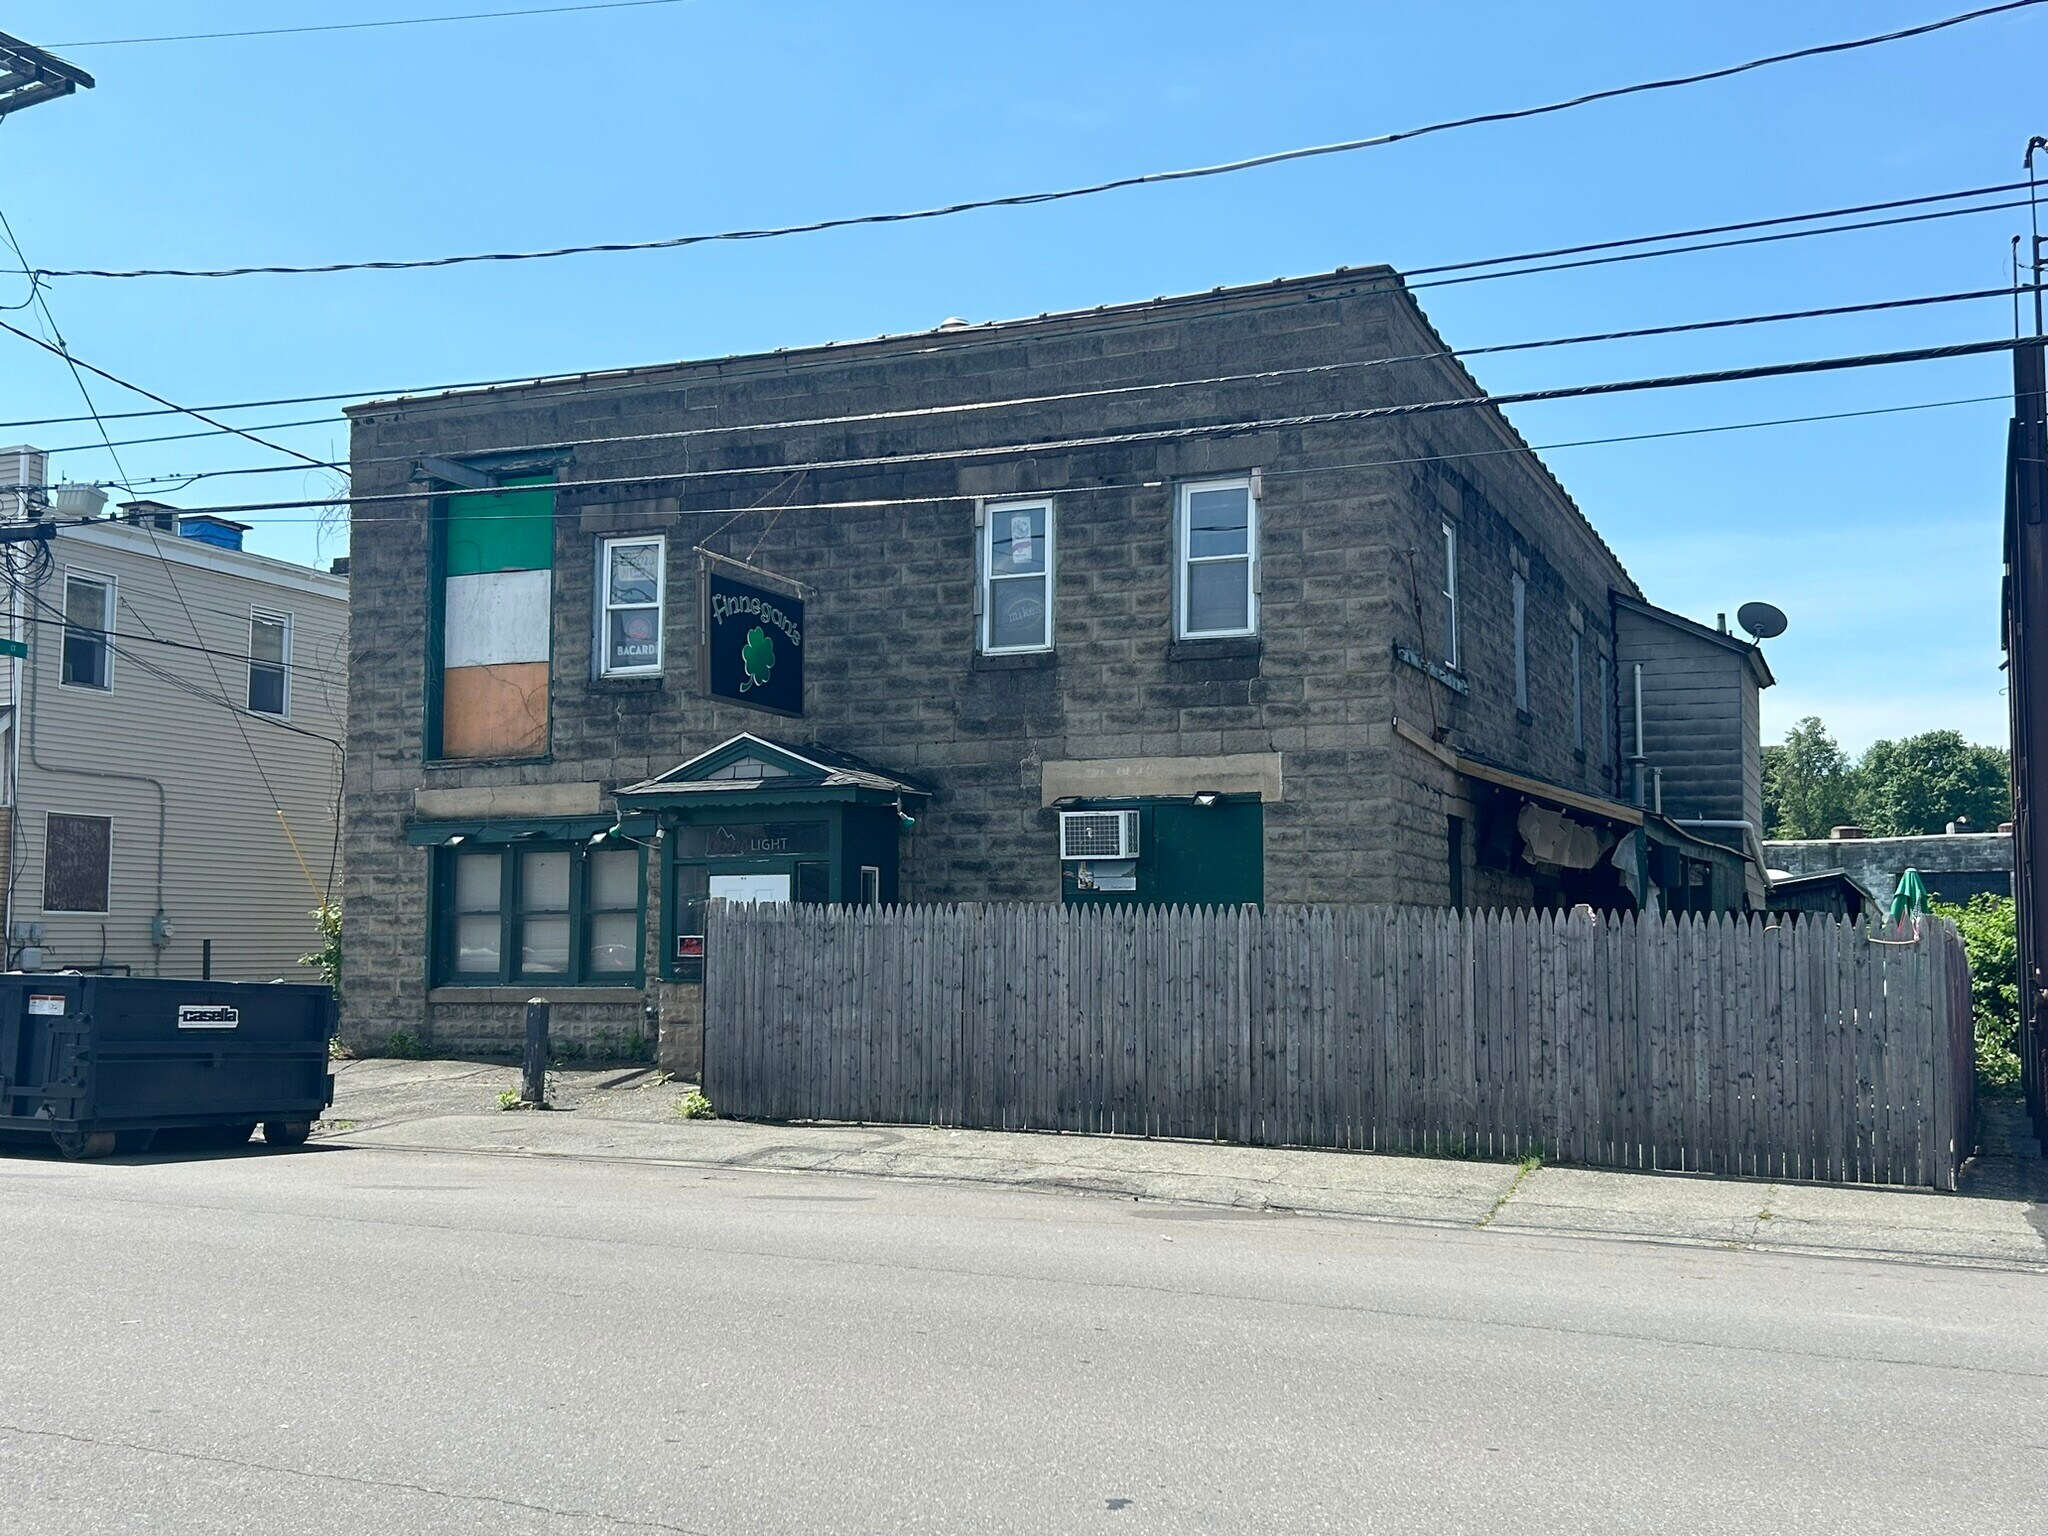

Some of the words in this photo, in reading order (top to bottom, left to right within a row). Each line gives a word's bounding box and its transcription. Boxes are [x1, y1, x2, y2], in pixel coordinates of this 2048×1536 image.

[712, 593, 802, 646] Finnegan's
[750, 838, 788, 851] LIGHT
[183, 1008, 237, 1021] casella
